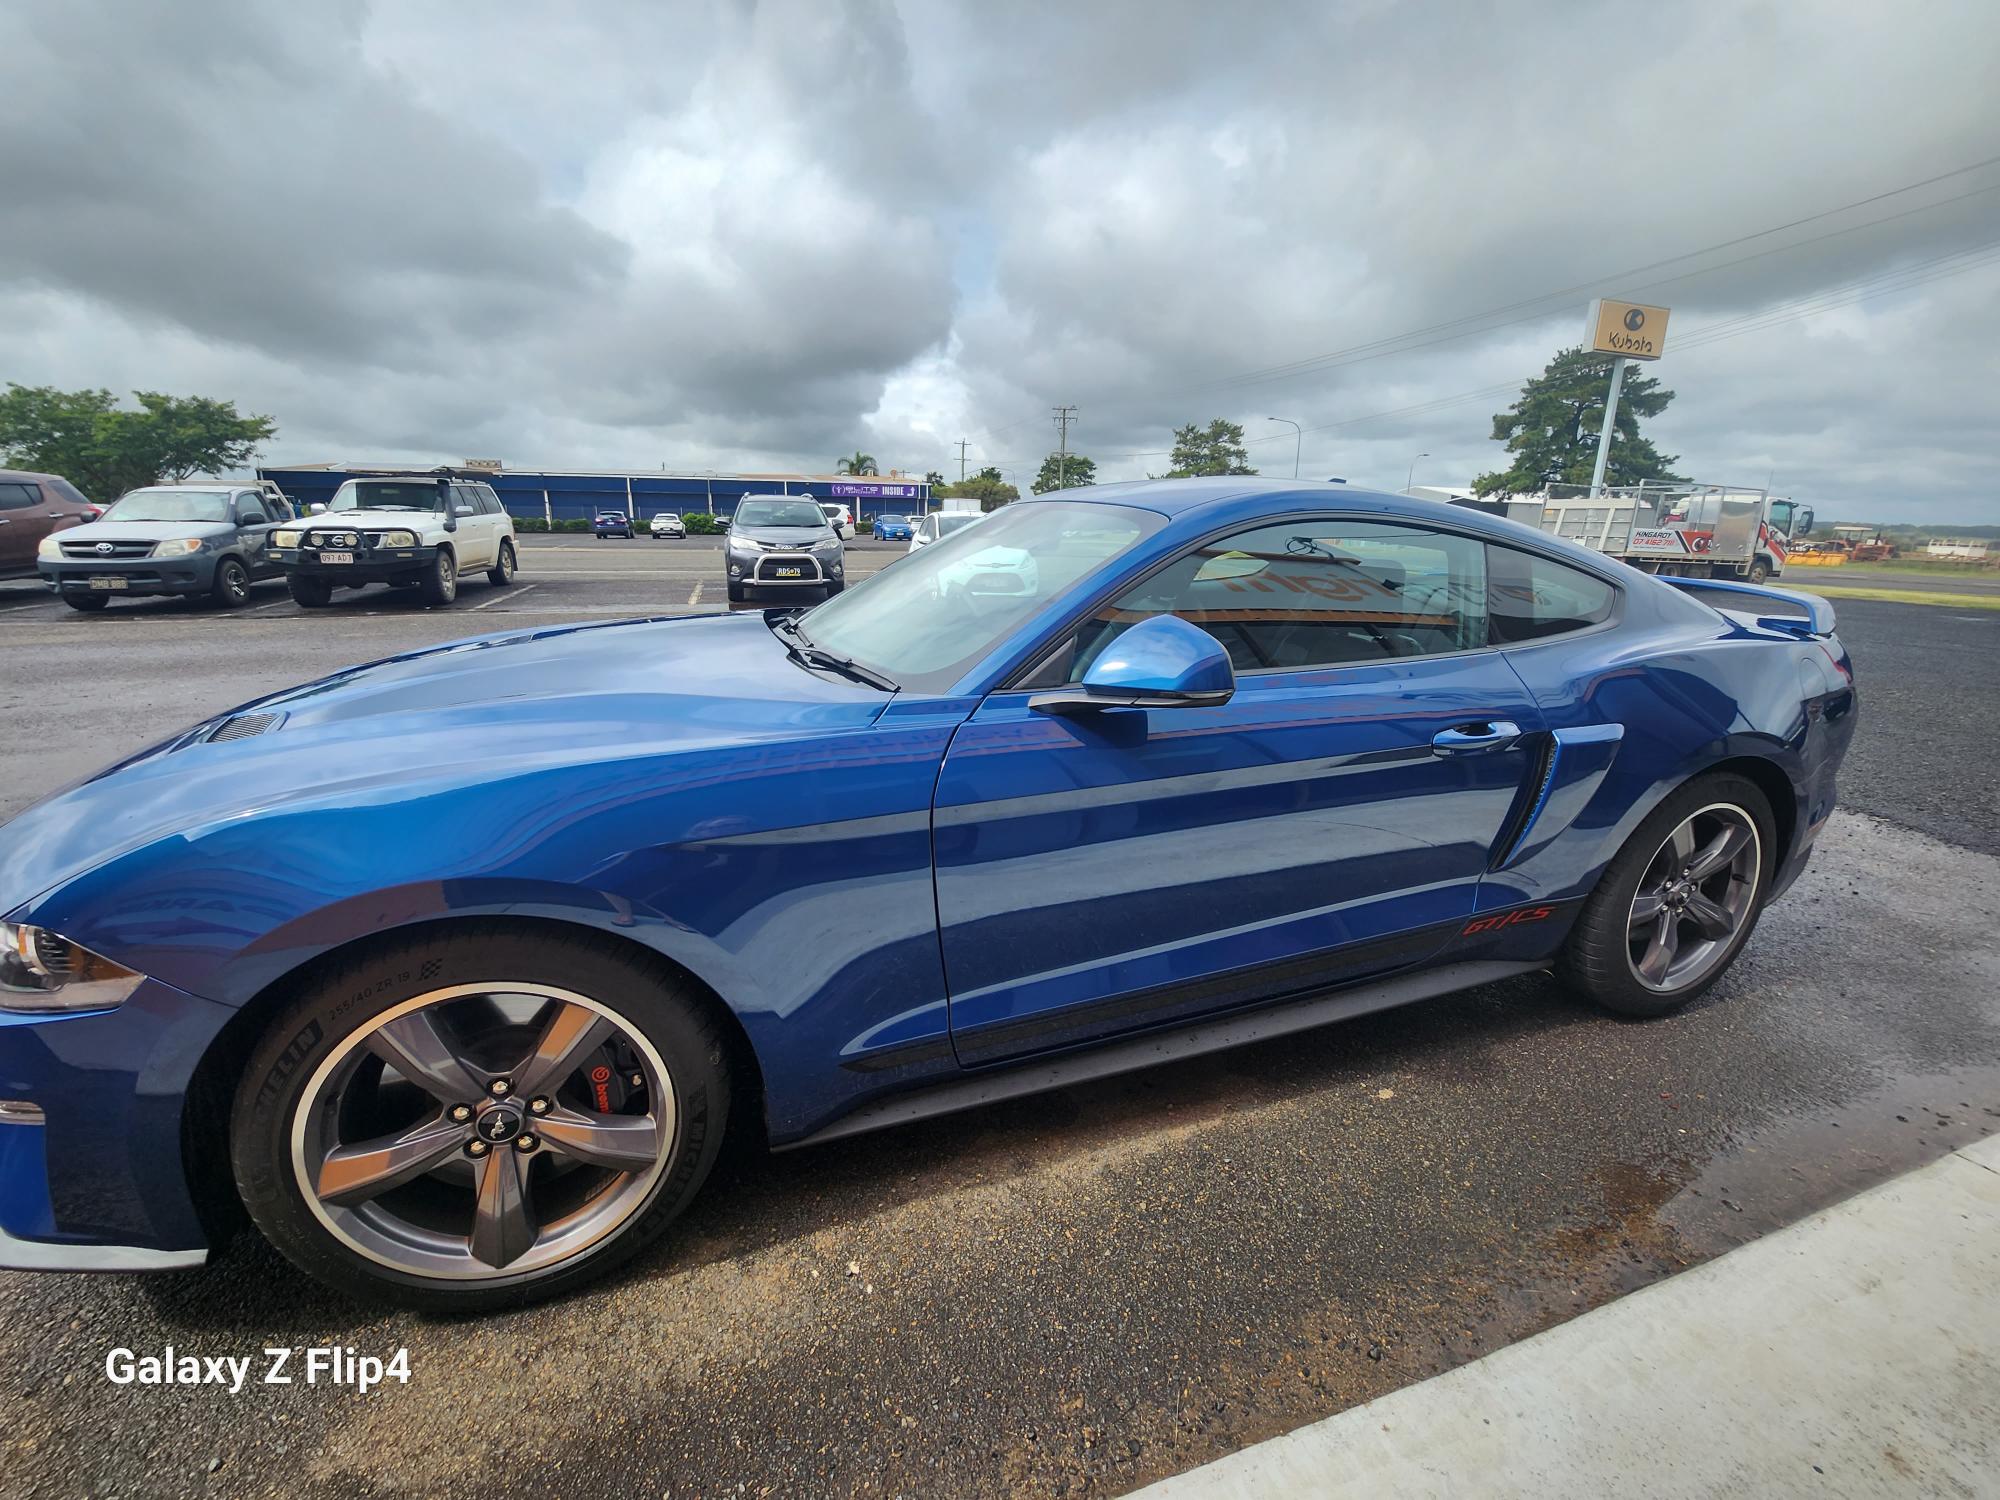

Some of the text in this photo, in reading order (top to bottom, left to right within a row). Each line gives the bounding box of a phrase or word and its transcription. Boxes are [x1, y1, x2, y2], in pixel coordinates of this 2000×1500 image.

[1608, 331, 1653, 352] Kubota
[882, 486, 905, 495] INSIDE
[1635, 531, 1673, 539] KINGAROY
[1463, 906, 1558, 936] GT/CS
[328, 971, 410, 1021] 255/40 ZR 19
